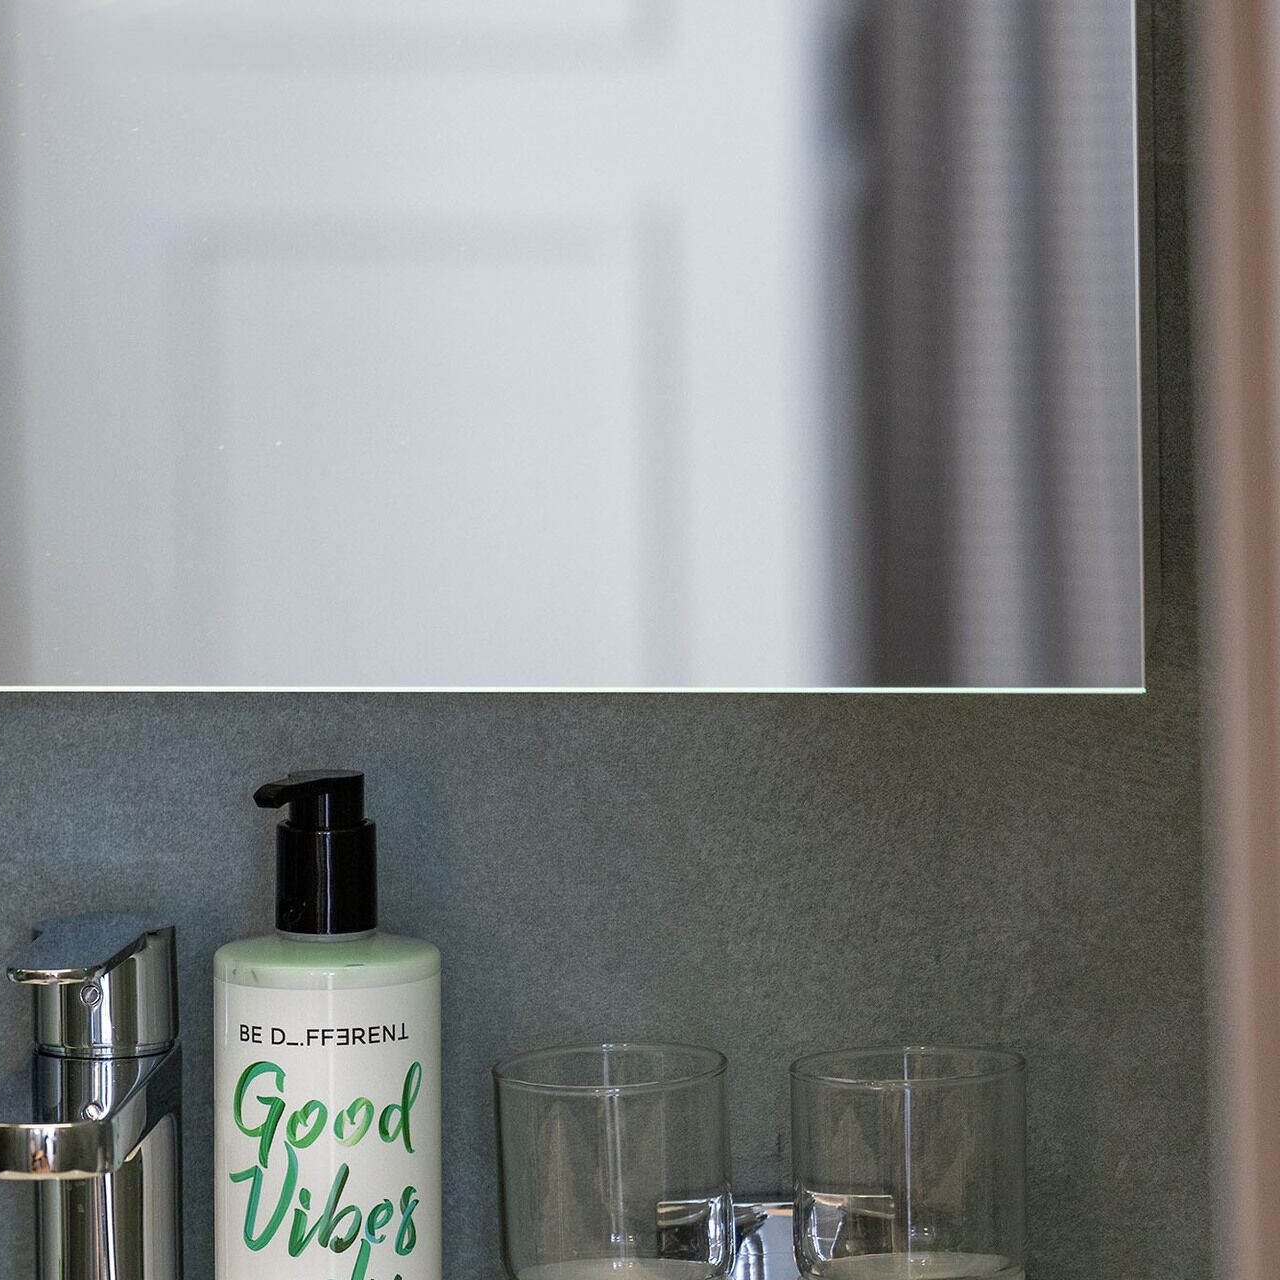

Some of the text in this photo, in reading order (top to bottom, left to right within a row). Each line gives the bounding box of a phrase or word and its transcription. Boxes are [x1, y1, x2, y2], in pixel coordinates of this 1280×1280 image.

[240, 1024, 262, 1044] BE
[233, 1060, 423, 1169] Good
[229, 1140, 420, 1257] Vibes
